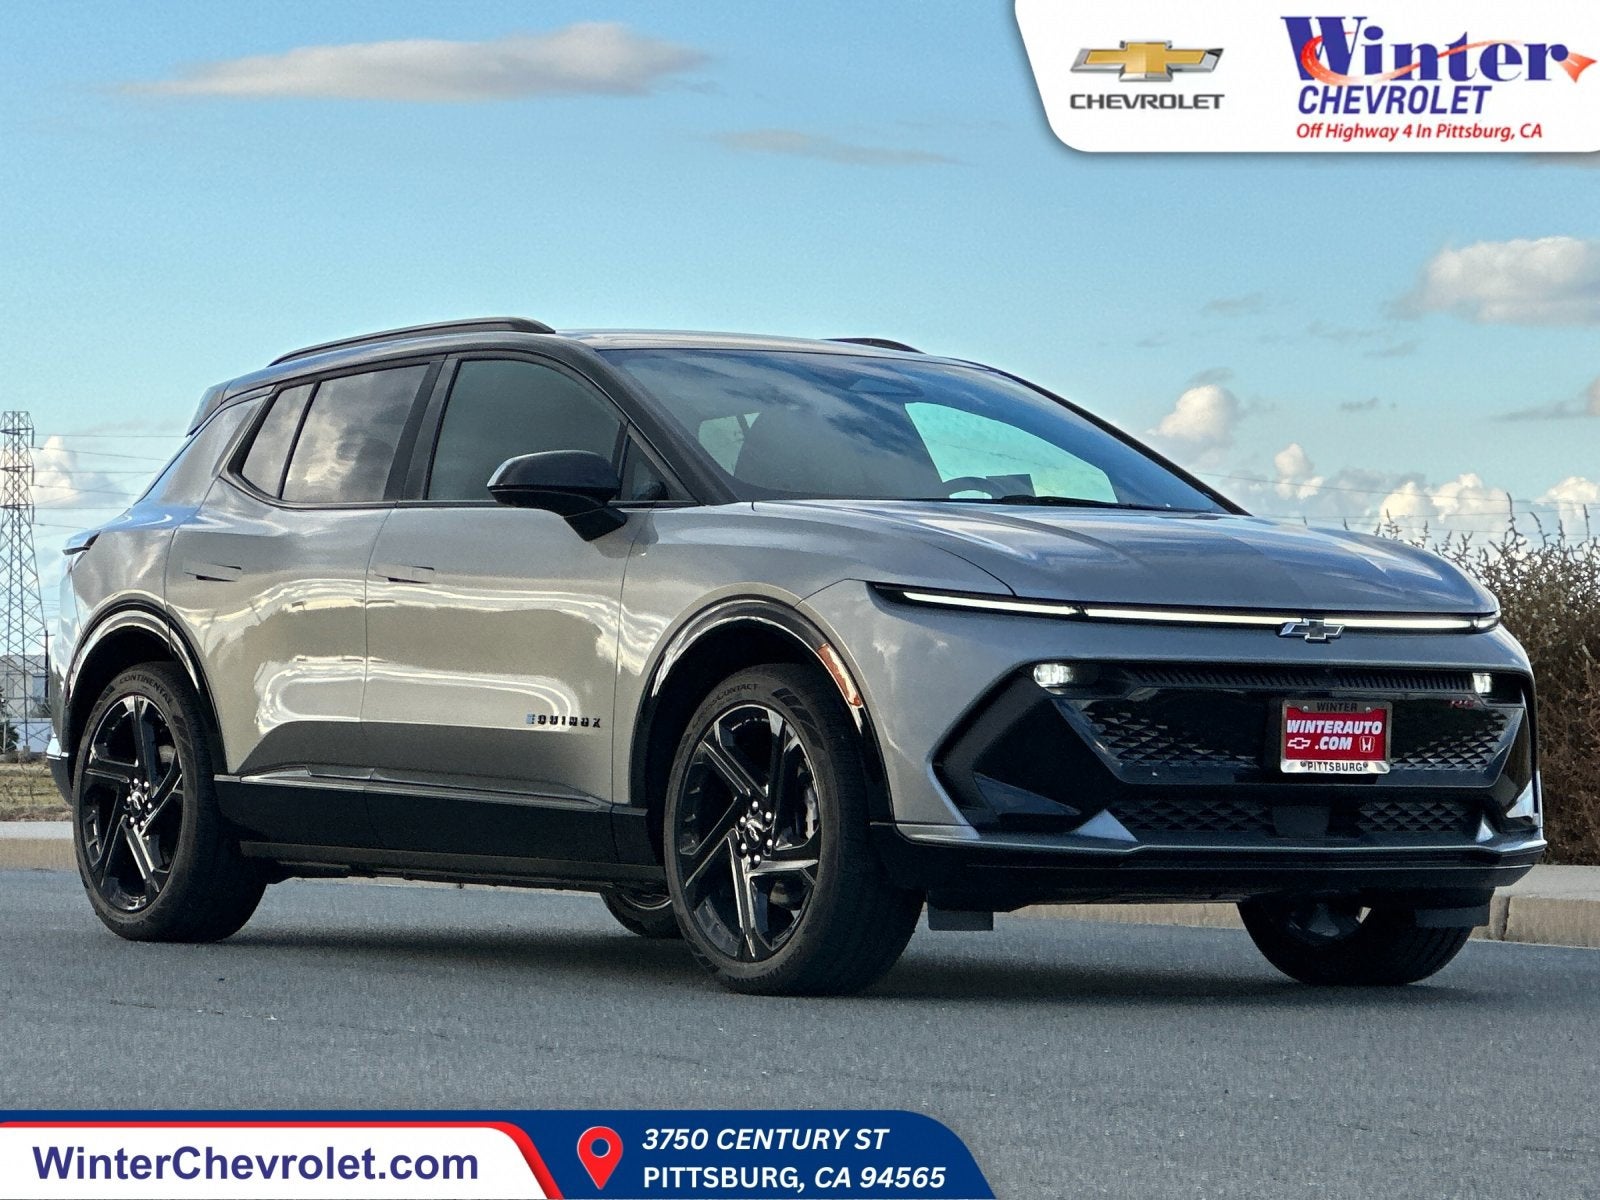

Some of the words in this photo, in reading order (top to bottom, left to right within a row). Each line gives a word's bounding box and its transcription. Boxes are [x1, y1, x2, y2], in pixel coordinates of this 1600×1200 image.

[119, 673, 172, 704] CONTINENTAL
[1316, 701, 1358, 712] WINTER
[526, 713, 601, 728] EQUINOX
[1287, 719, 1382, 735] WINTERAUTO
[1315, 736, 1353, 751] .COM
[1306, 761, 1363, 772] PITTSBURG
